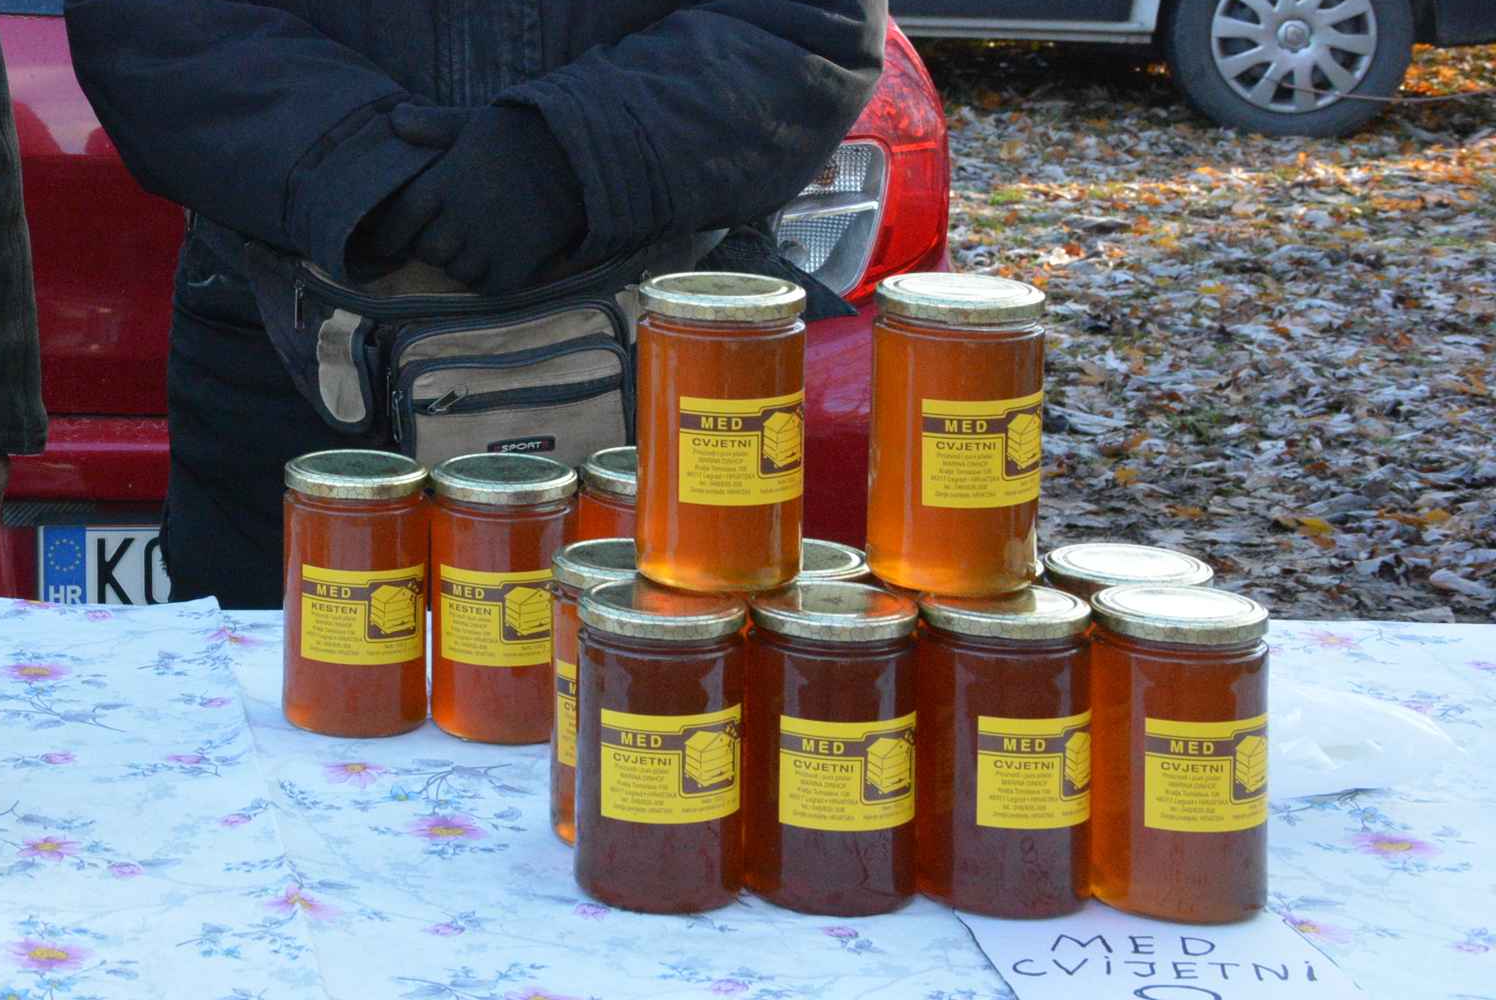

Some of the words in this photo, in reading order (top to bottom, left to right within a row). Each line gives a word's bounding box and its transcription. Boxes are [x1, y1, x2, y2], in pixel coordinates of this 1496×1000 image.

[700, 417, 744, 431] MED
[944, 419, 989, 433] MED
[691, 437, 752, 448] CVJETNI
[935, 441, 997, 451] CVJETNI
[48, 585, 82, 604] HR
[316, 584, 352, 599] MED
[452, 584, 485, 599] MED
[311, 602, 358, 614] KESTEN
[448, 602, 492, 616] KESTEN
[621, 731, 662, 749] MED
[802, 738, 845, 754] MED
[1003, 738, 1047, 752] MED
[1169, 738, 1215, 755] MED
[612, 752, 672, 767] CVJETNI
[793, 759, 855, 773] CVJETNI
[993, 759, 1055, 771] CVJETNI
[1160, 761, 1224, 773] CVJETNI
[1051, 934, 1216, 956] MED
